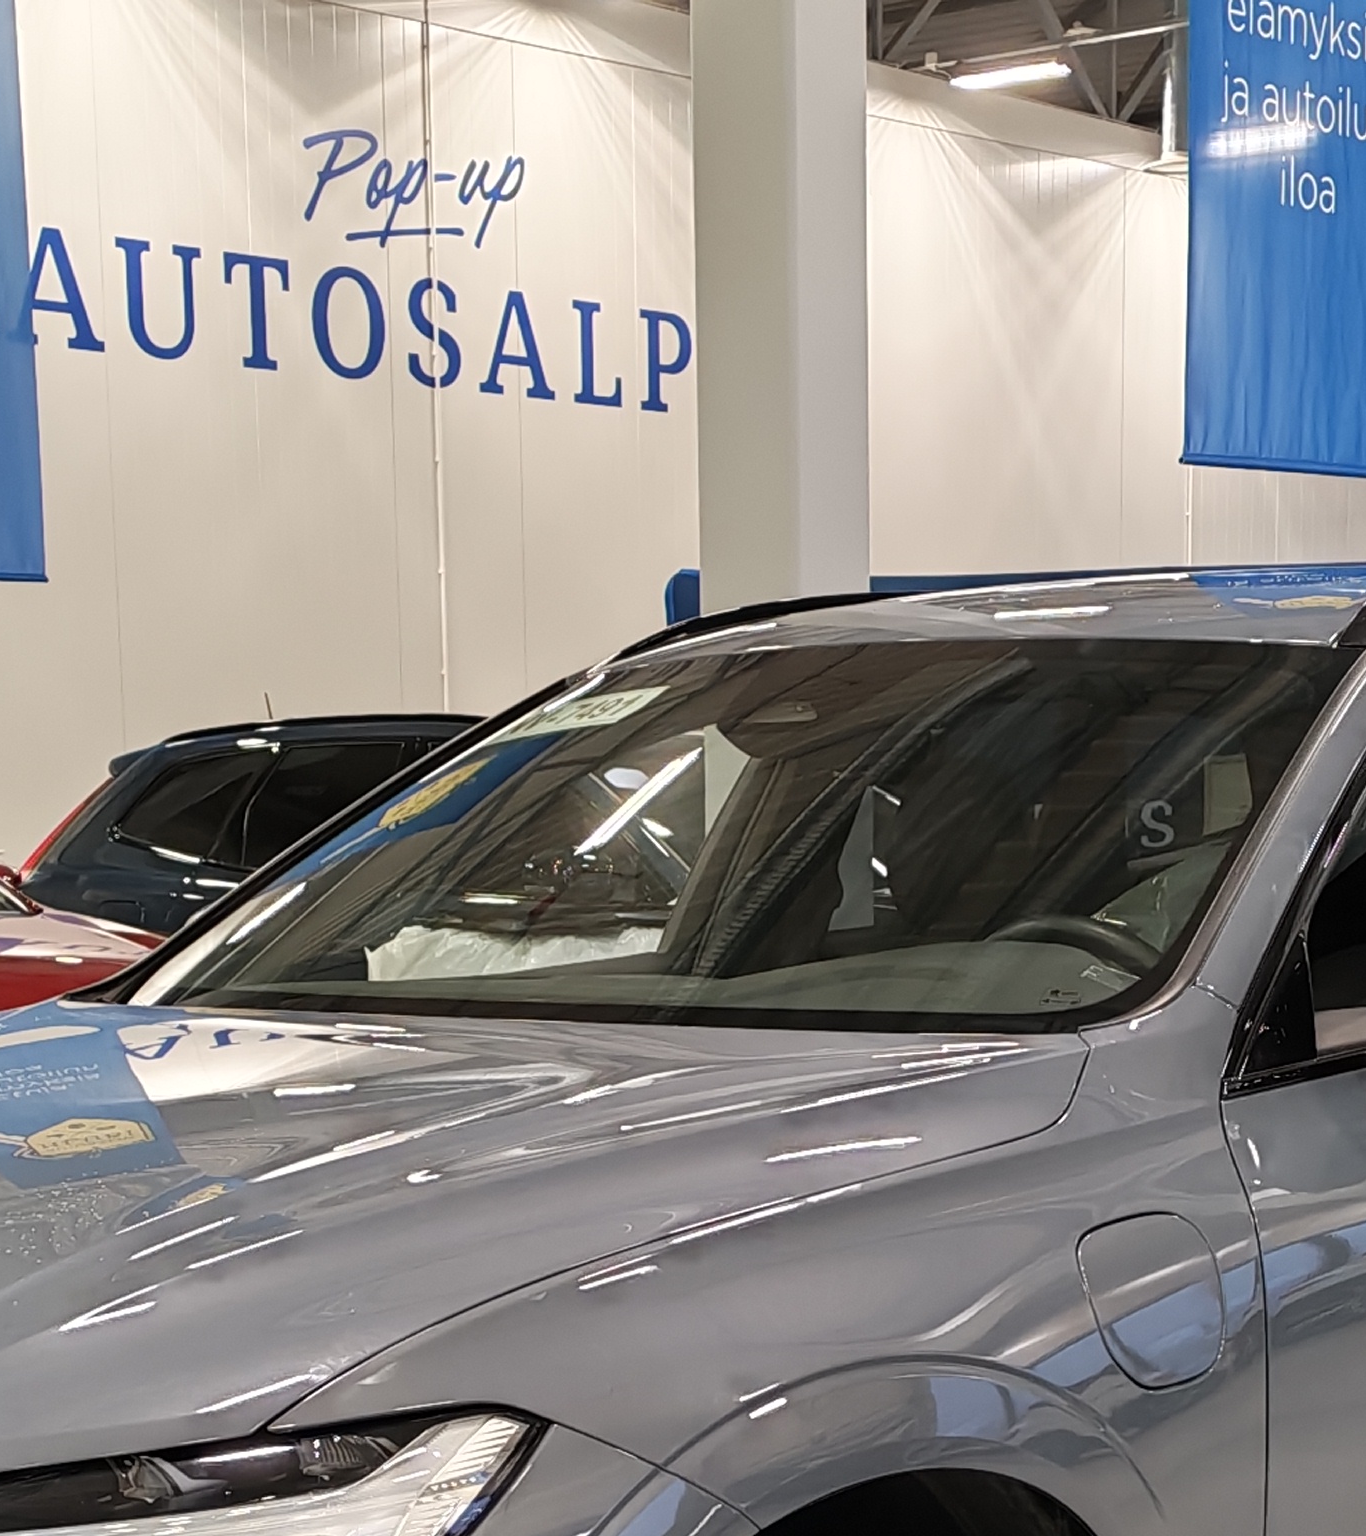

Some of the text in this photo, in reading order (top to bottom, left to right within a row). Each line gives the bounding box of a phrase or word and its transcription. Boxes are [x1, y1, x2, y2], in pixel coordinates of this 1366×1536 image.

[1221, 59, 1249, 123] ja
[302, 128, 526, 250] Pop-up
[1280, 154, 1336, 214] iloa
[9, 226, 692, 413] AUTOSALP
